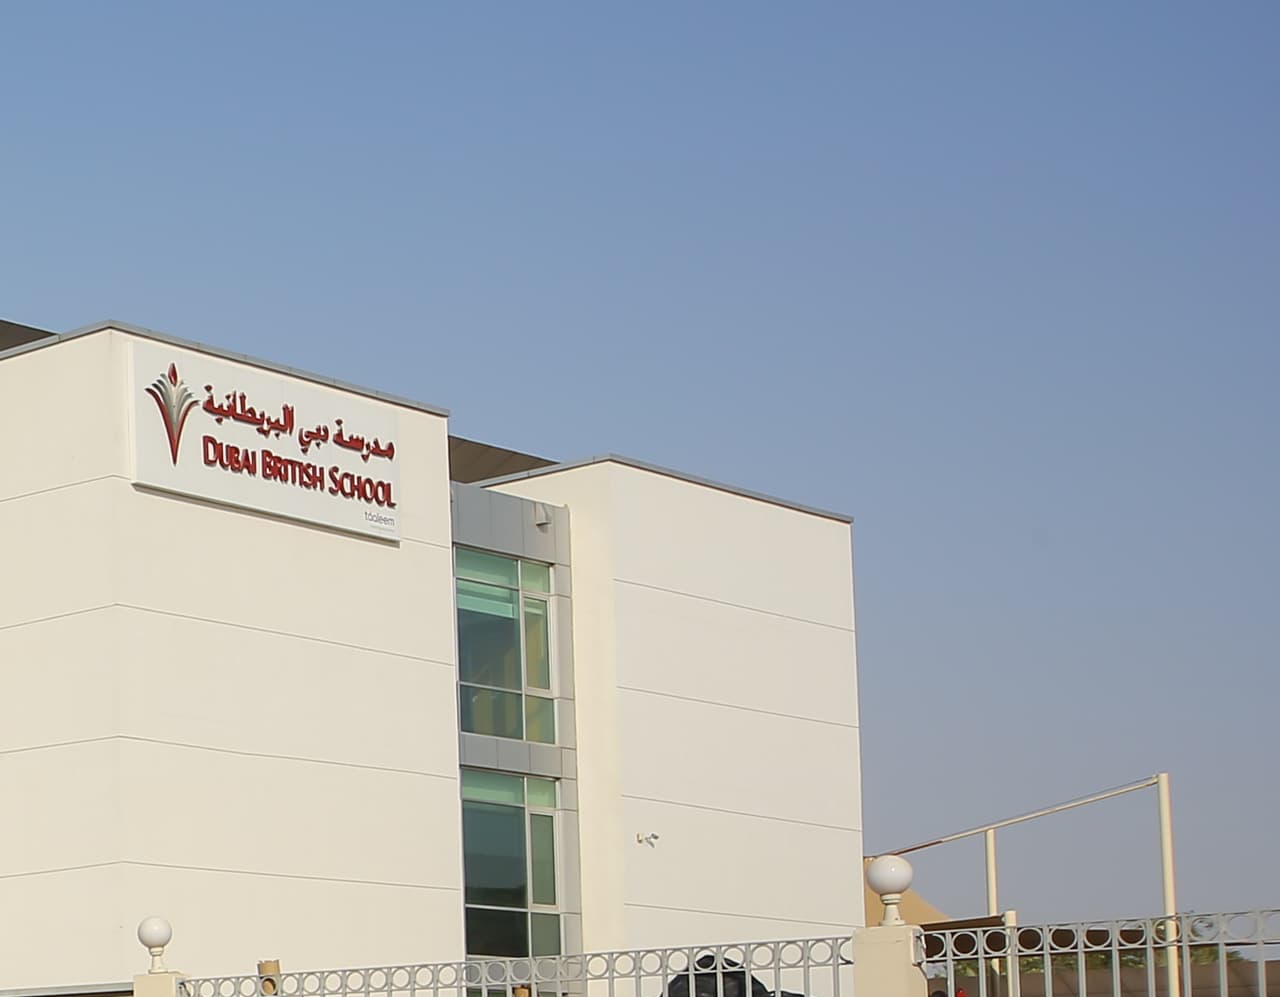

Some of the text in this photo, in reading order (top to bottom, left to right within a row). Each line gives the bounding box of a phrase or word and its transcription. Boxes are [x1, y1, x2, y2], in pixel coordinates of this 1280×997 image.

[203, 385, 395, 462] مدرسة دبي البريطانية
[203, 436, 396, 508] DUBAI BRITISH SCHOOL
